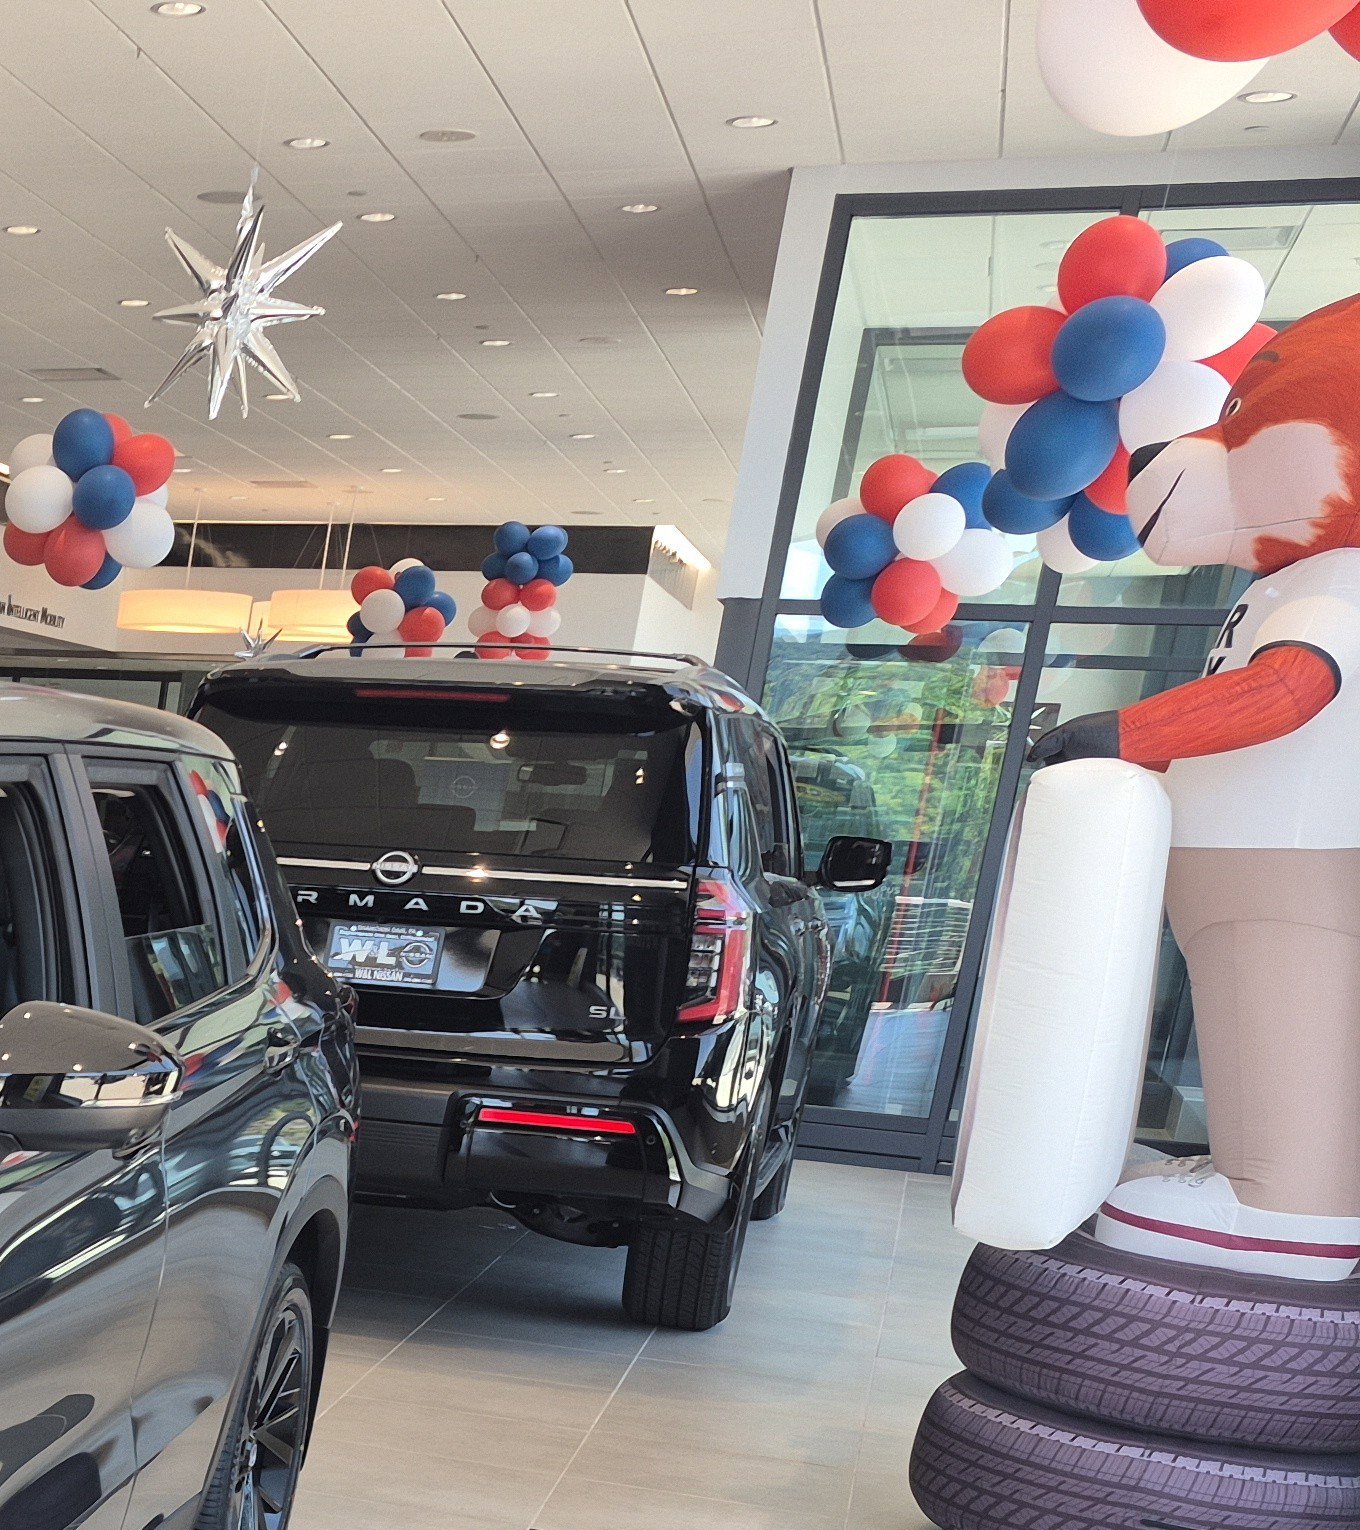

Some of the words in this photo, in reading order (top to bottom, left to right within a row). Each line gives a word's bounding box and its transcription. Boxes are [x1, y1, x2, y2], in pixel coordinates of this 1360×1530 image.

[1215, 603, 1249, 649] R
[297, 890, 542, 919] RMADA
[589, 1005, 626, 1019] SL
